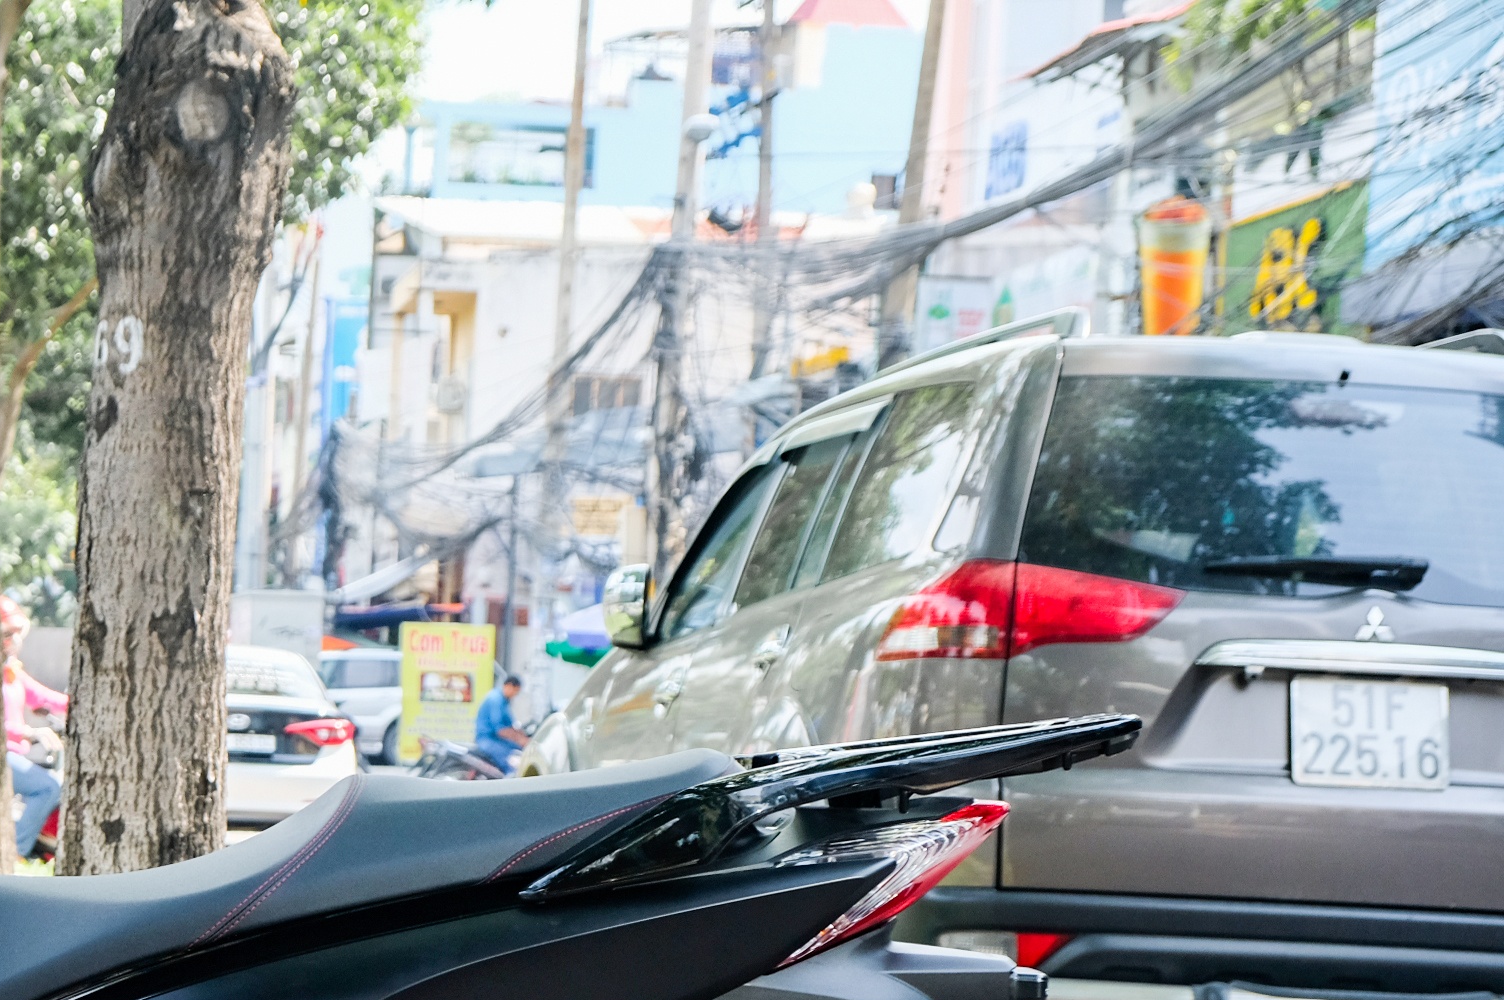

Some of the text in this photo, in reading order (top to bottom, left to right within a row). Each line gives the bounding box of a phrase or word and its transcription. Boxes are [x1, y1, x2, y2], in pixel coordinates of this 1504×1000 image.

[94, 314, 144, 375] 69
[1330, 683, 1410, 731] 51F
[1301, 731, 1440, 780] 225.16
